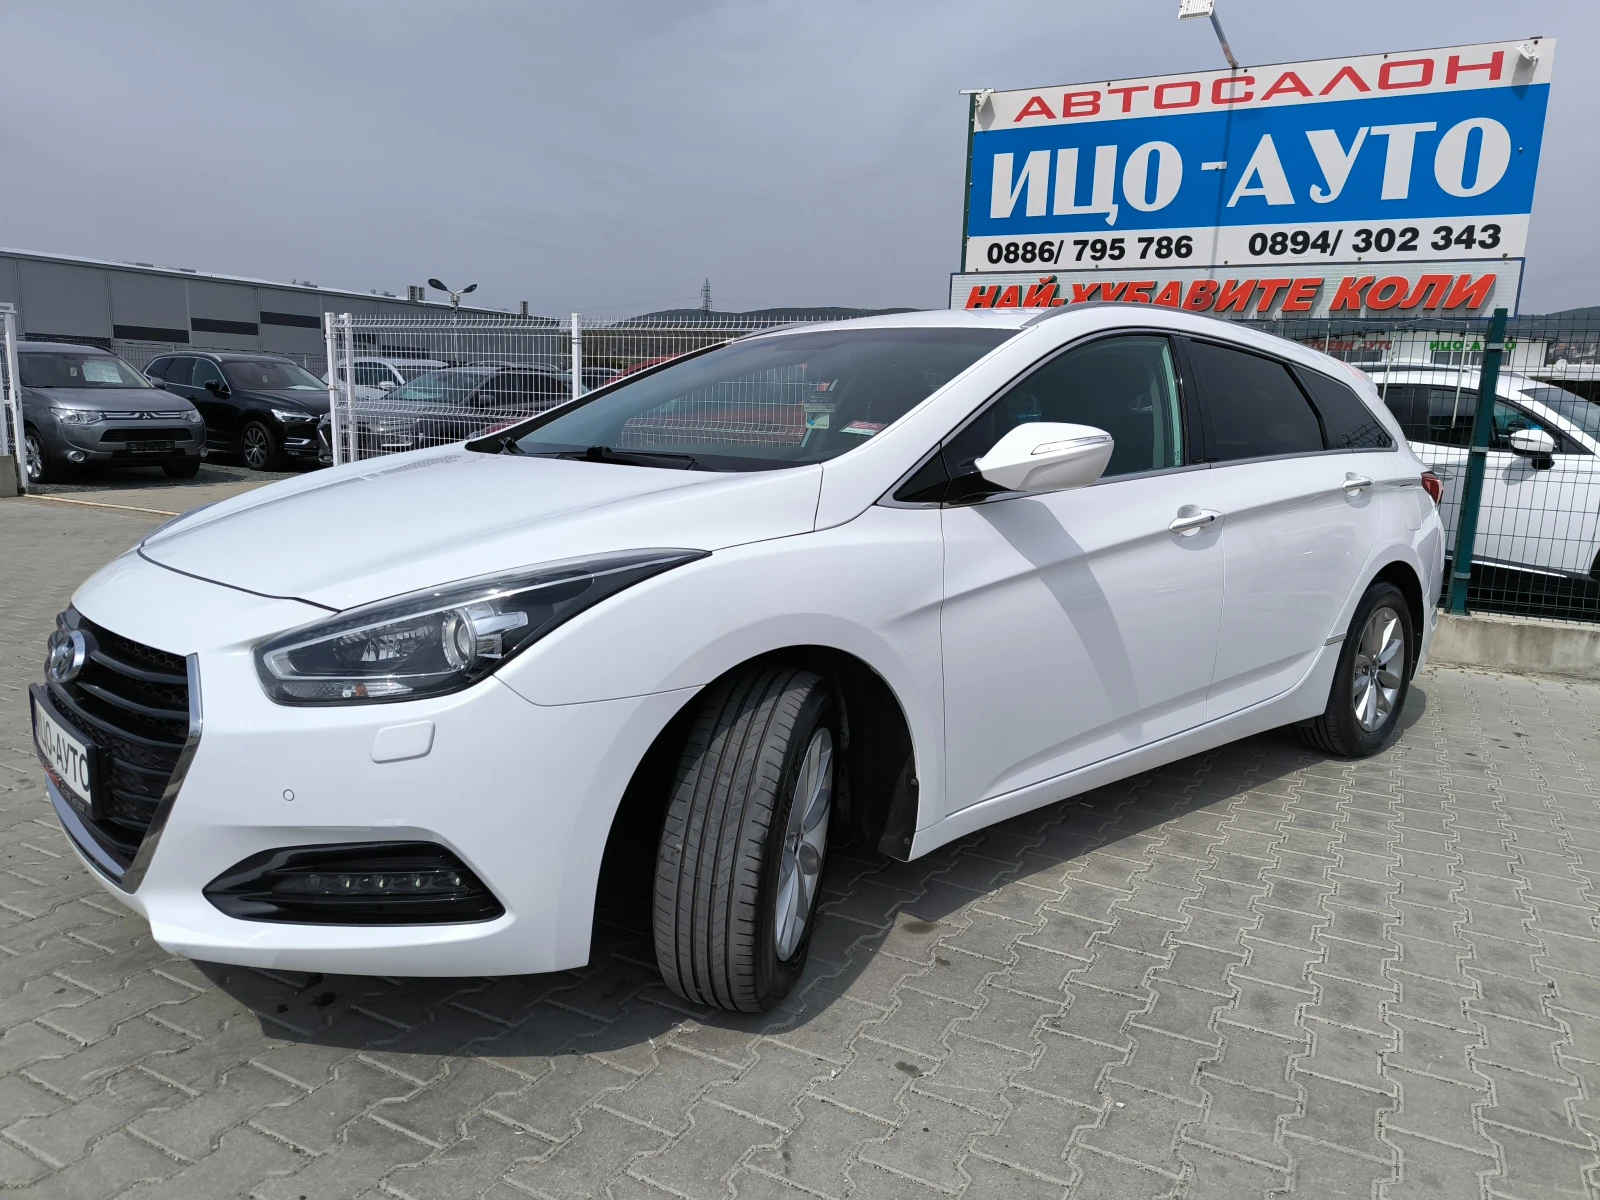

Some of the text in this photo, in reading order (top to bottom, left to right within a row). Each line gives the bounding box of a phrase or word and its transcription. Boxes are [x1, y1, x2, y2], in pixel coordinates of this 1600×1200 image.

[1013, 50, 1505, 122] АВТОСАЛОН
[987, 224, 1502, 265] 0886/ 795 786 0894/ 302 343
[1328, 273, 1497, 311] КОЛИ
